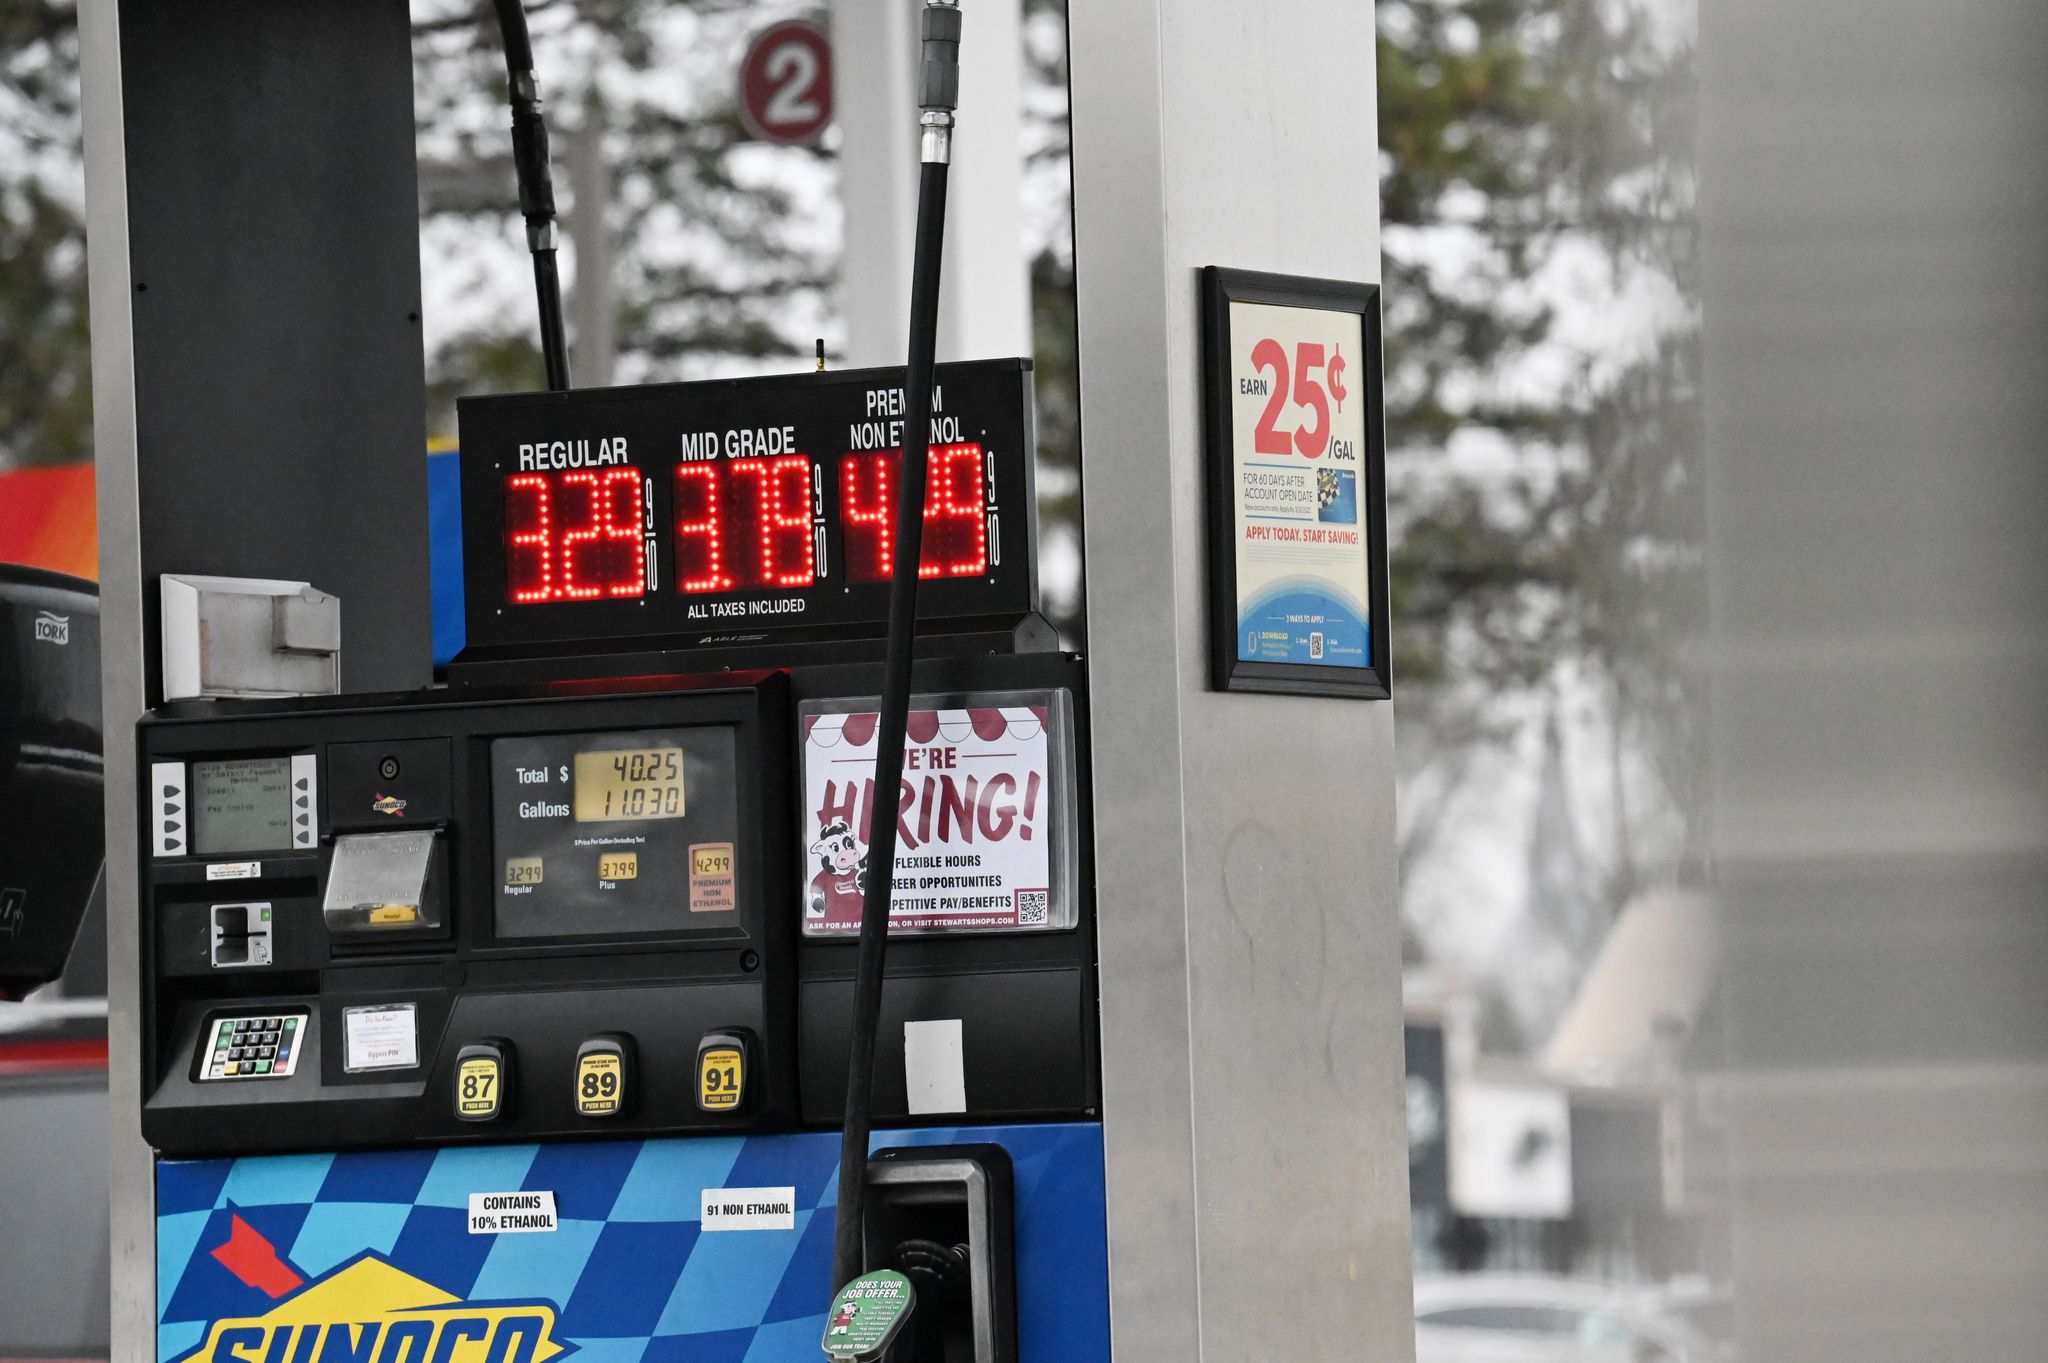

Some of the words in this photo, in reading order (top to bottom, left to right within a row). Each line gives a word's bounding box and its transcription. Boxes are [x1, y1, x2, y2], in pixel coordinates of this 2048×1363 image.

[766, 41, 820, 123] 2
[866, 385, 942, 417] PREMM
[1240, 378, 1267, 396] EARN
[1329, 436, 1356, 461] /GAL
[681, 432, 719, 461] MID
[724, 426, 796, 458] GRADE
[850, 422, 885, 450] NON
[519, 437, 628, 471] REGULAR
[1243, 473, 1258, 485] FOR
[1259, 474, 1268, 485] 60
[1269, 475, 1286, 487] DAYS
[1286, 476, 1305, 488] AFTER
[1244, 488, 1277, 501] ACCOUNT
[1279, 489, 1297, 501] OPEN
[1297, 490, 1313, 502] DATE
[1246, 526, 1271, 540] APPLY
[1273, 527, 1302, 541] TODAY.
[1303, 529, 1327, 543] START
[1327, 531, 1359, 545] SAVING!
[688, 604, 708, 619] ALL
[711, 601, 746, 617] TAXES
[749, 599, 805, 615] INCLUDED
[37, 621, 67, 640] TORK
[516, 767, 549, 784] Total
[559, 765, 569, 784] $
[614, 752, 678, 782] 40.25
[375, 801, 405, 809] SUNOCO
[519, 801, 570, 819] Gallons
[604, 787, 680, 816] 11.030
[895, 856, 942, 868] FLEXIBLE
[945, 855, 981, 867] HOURS
[599, 880, 616, 890] Plus
[693, 878, 732, 888] PREMIUM
[920, 875, 1002, 889] OPPORTUNITIES
[504, 885, 533, 896] Regular
[693, 899, 732, 907] ETHANOL
[940, 896, 1012, 910] PAY/BENEFITS
[808, 922, 824, 930] ASK
[914, 919, 931, 927] VISIT
[933, 917, 1014, 926] STEWARTSSHOPS.COM
[463, 1074, 495, 1099] 87
[581, 1072, 617, 1098] 89
[706, 1067, 738, 1091] 91
[465, 1102, 478, 1110] PUSH
[479, 1101, 490, 1109] HERE
[483, 1195, 541, 1210] CONTAINS
[707, 1205, 720, 1216] 91
[722, 1204, 744, 1216] NON
[746, 1202, 791, 1215] ETHANOL
[471, 1215, 497, 1230] 10%
[500, 1214, 554, 1229] ETHANOL
[855, 1281, 878, 1289] DOES
[880, 1280, 903, 1288] YOUR
[842, 1289, 862, 1299] JOB
[864, 1289, 905, 1299] OFFER...
[210, 1316, 544, 1363] SUNOCO
